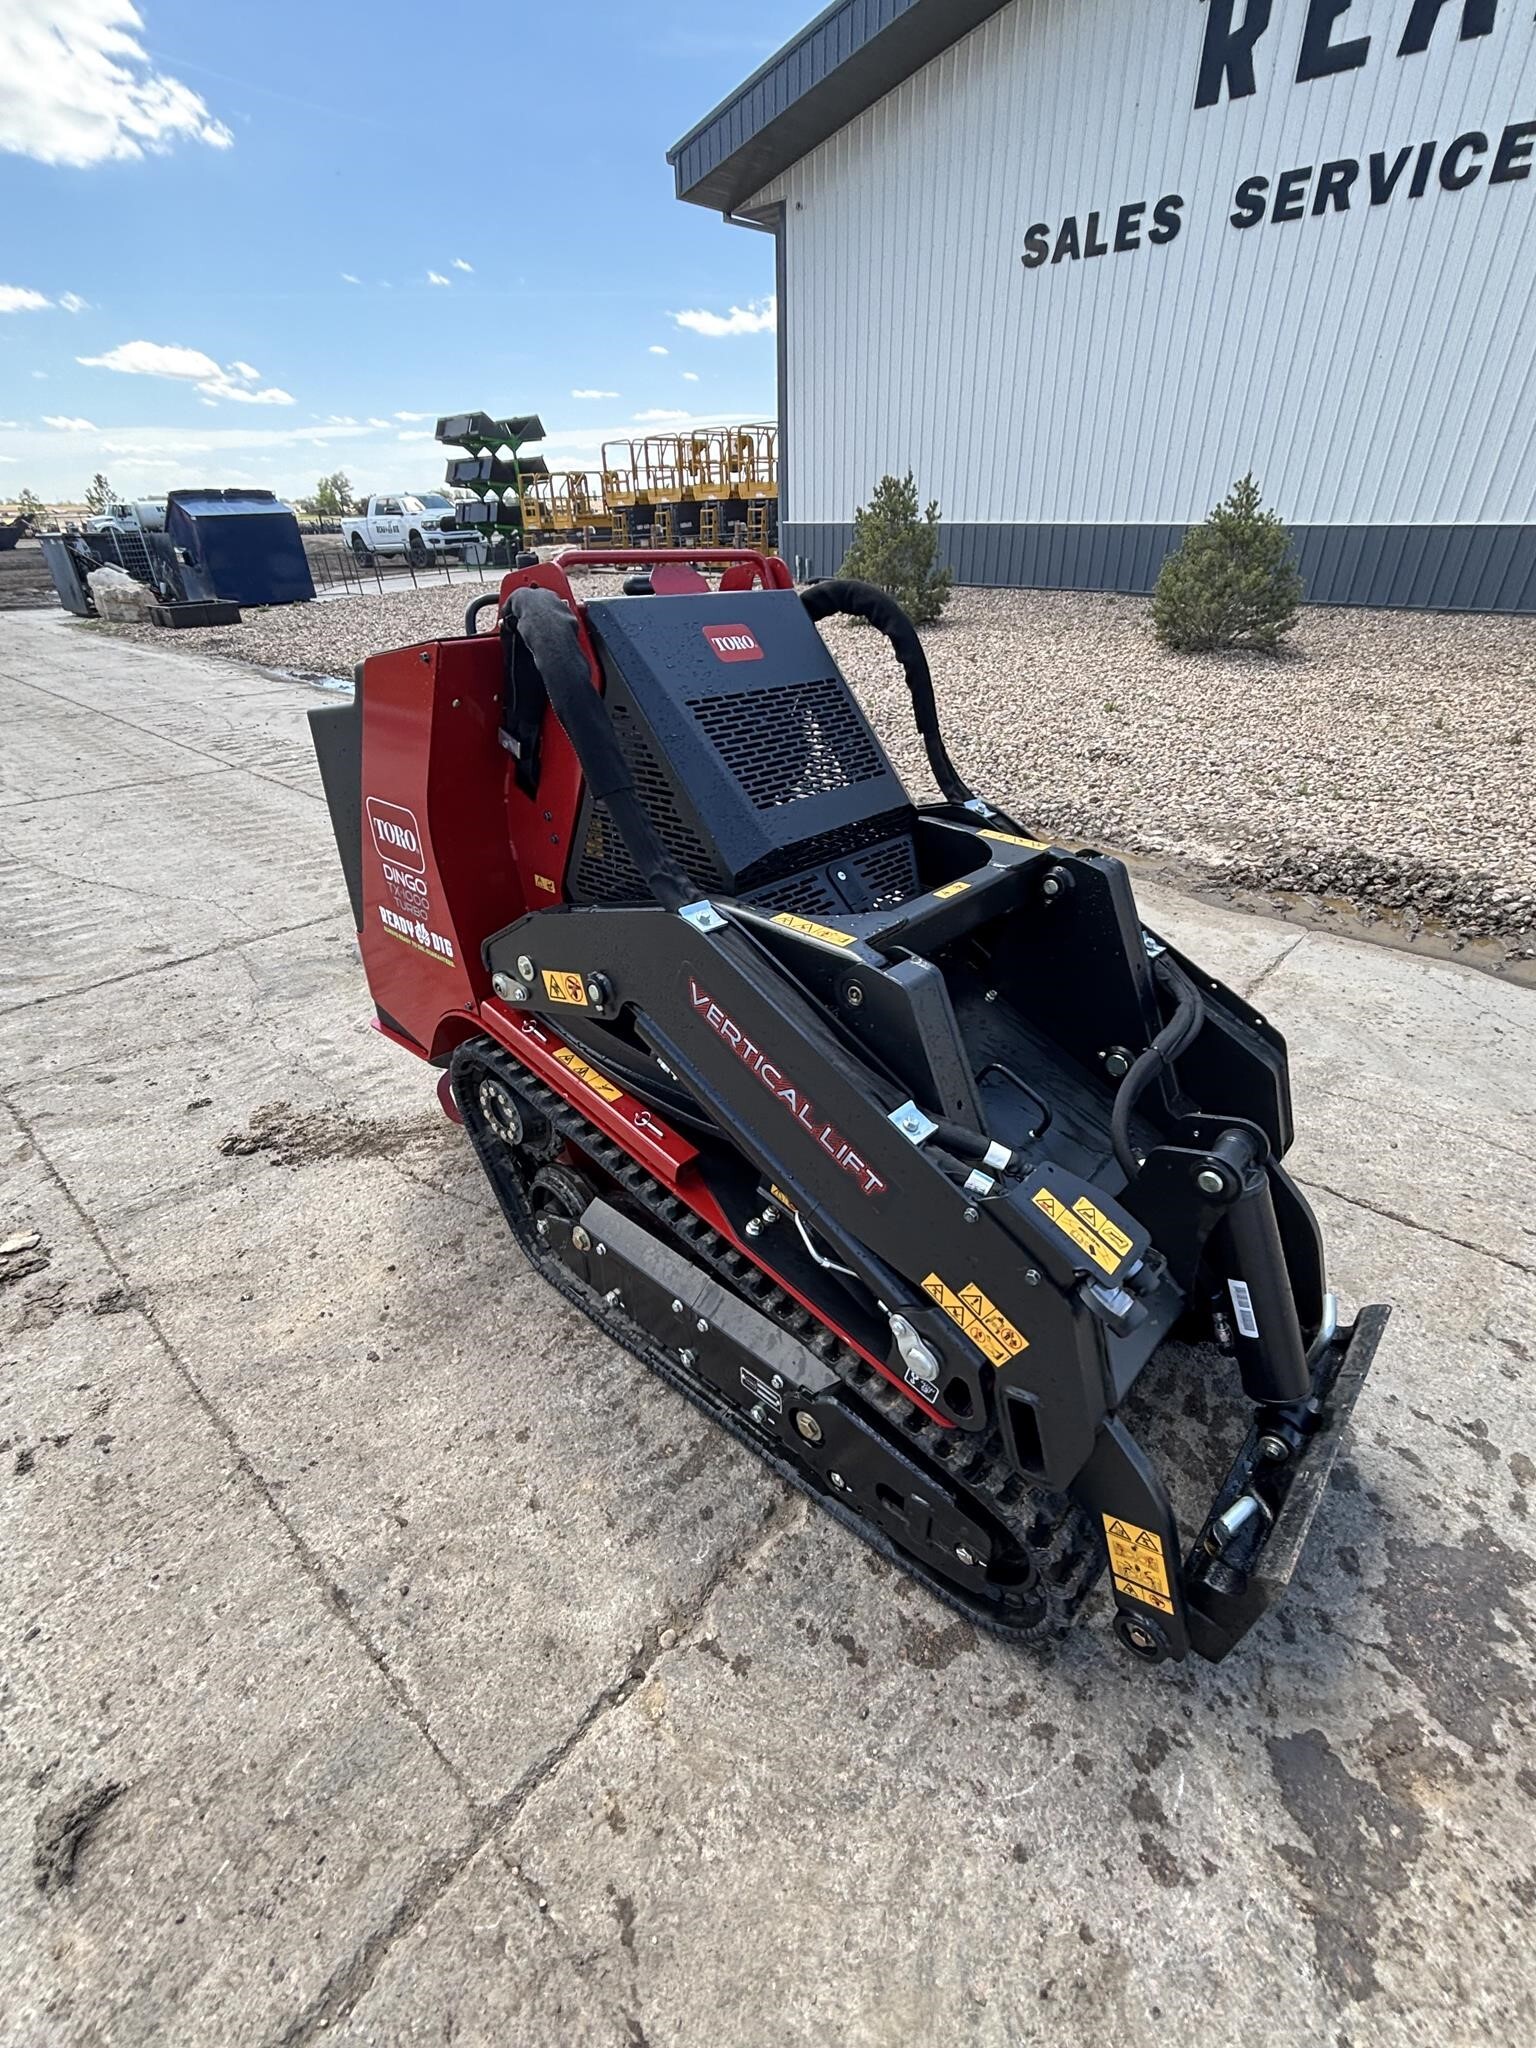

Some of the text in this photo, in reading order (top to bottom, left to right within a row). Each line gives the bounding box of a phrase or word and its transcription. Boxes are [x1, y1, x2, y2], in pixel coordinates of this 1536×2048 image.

[1021, 120, 1536, 268] SALES SERVICE
[711, 634, 756, 652] TORO
[373, 817, 417, 852] TORO
[382, 862, 428, 896] DINGO
[393, 896, 428, 921] TURBO
[378, 905, 414, 938] READY
[430, 931, 454, 958] DIG
[689, 979, 885, 1192] VERTICAL LIFT
